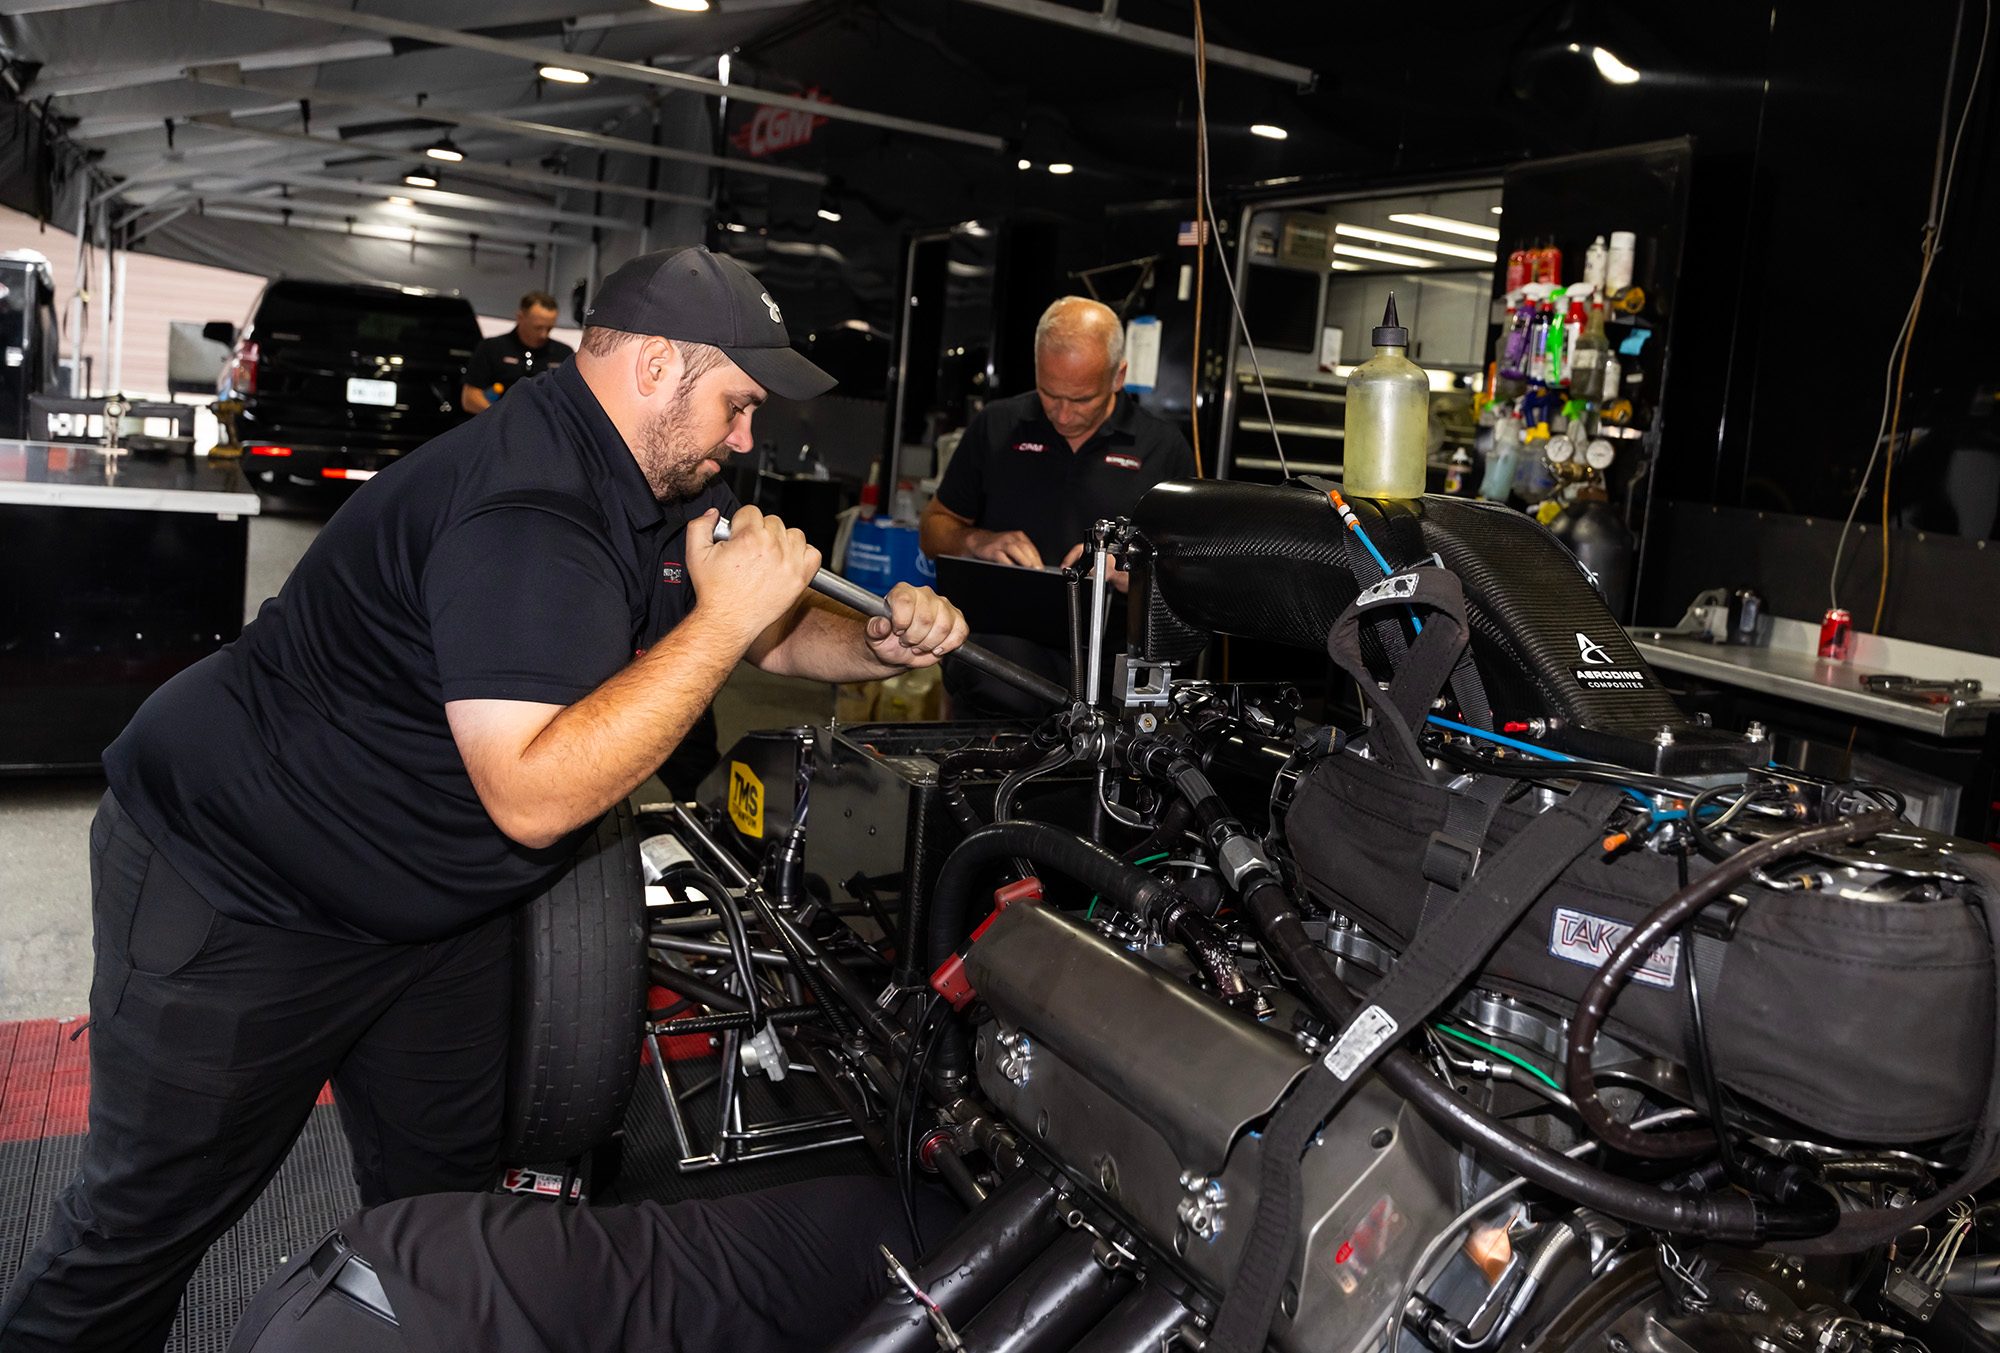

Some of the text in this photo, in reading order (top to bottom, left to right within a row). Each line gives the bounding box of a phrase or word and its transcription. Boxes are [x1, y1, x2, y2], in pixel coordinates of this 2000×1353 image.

[1576, 670, 1644, 680] AERODINE
[1587, 681, 1644, 689] COMPOSITES
[734, 771, 758, 817] TMS
